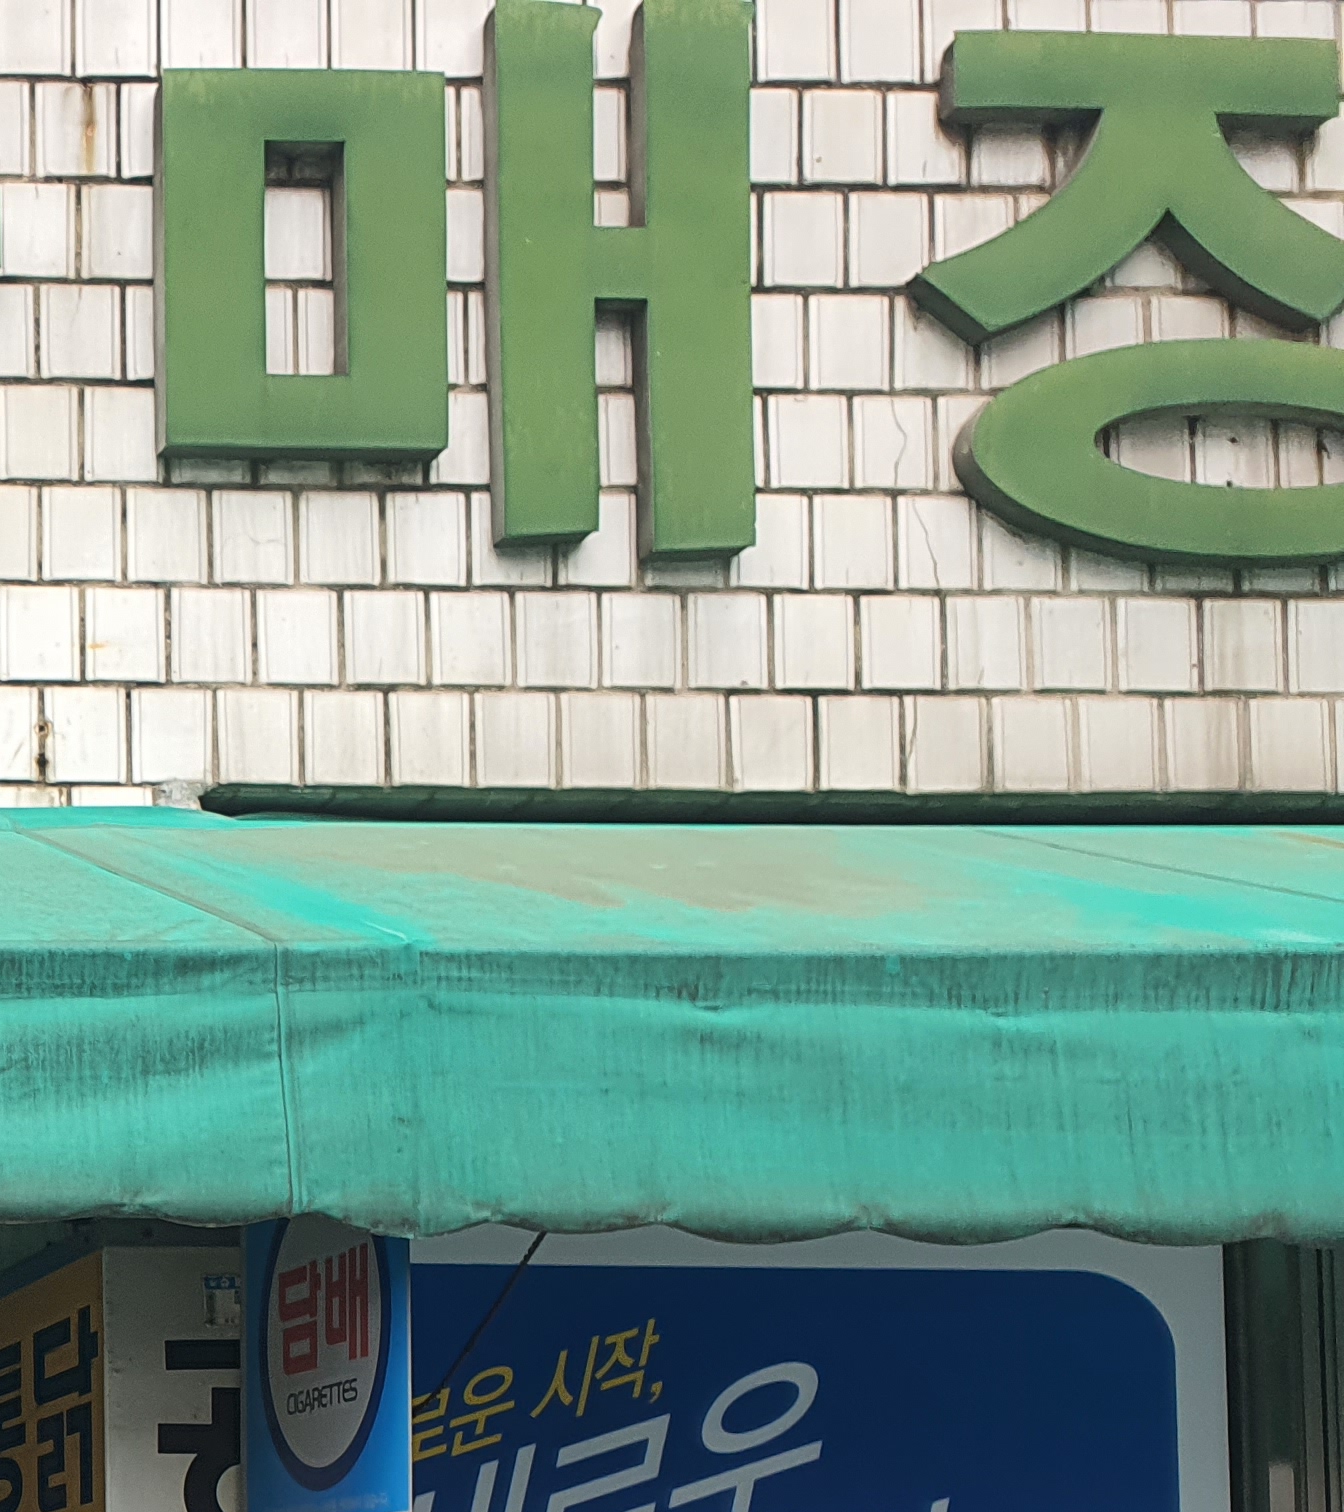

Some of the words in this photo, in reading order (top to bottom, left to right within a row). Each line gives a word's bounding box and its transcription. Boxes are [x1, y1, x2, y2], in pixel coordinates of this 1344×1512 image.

[278, 1243, 368, 1375] 담배
[412, 1366, 515, 1462] 로운
[530, 1317, 663, 1417] 시작,
